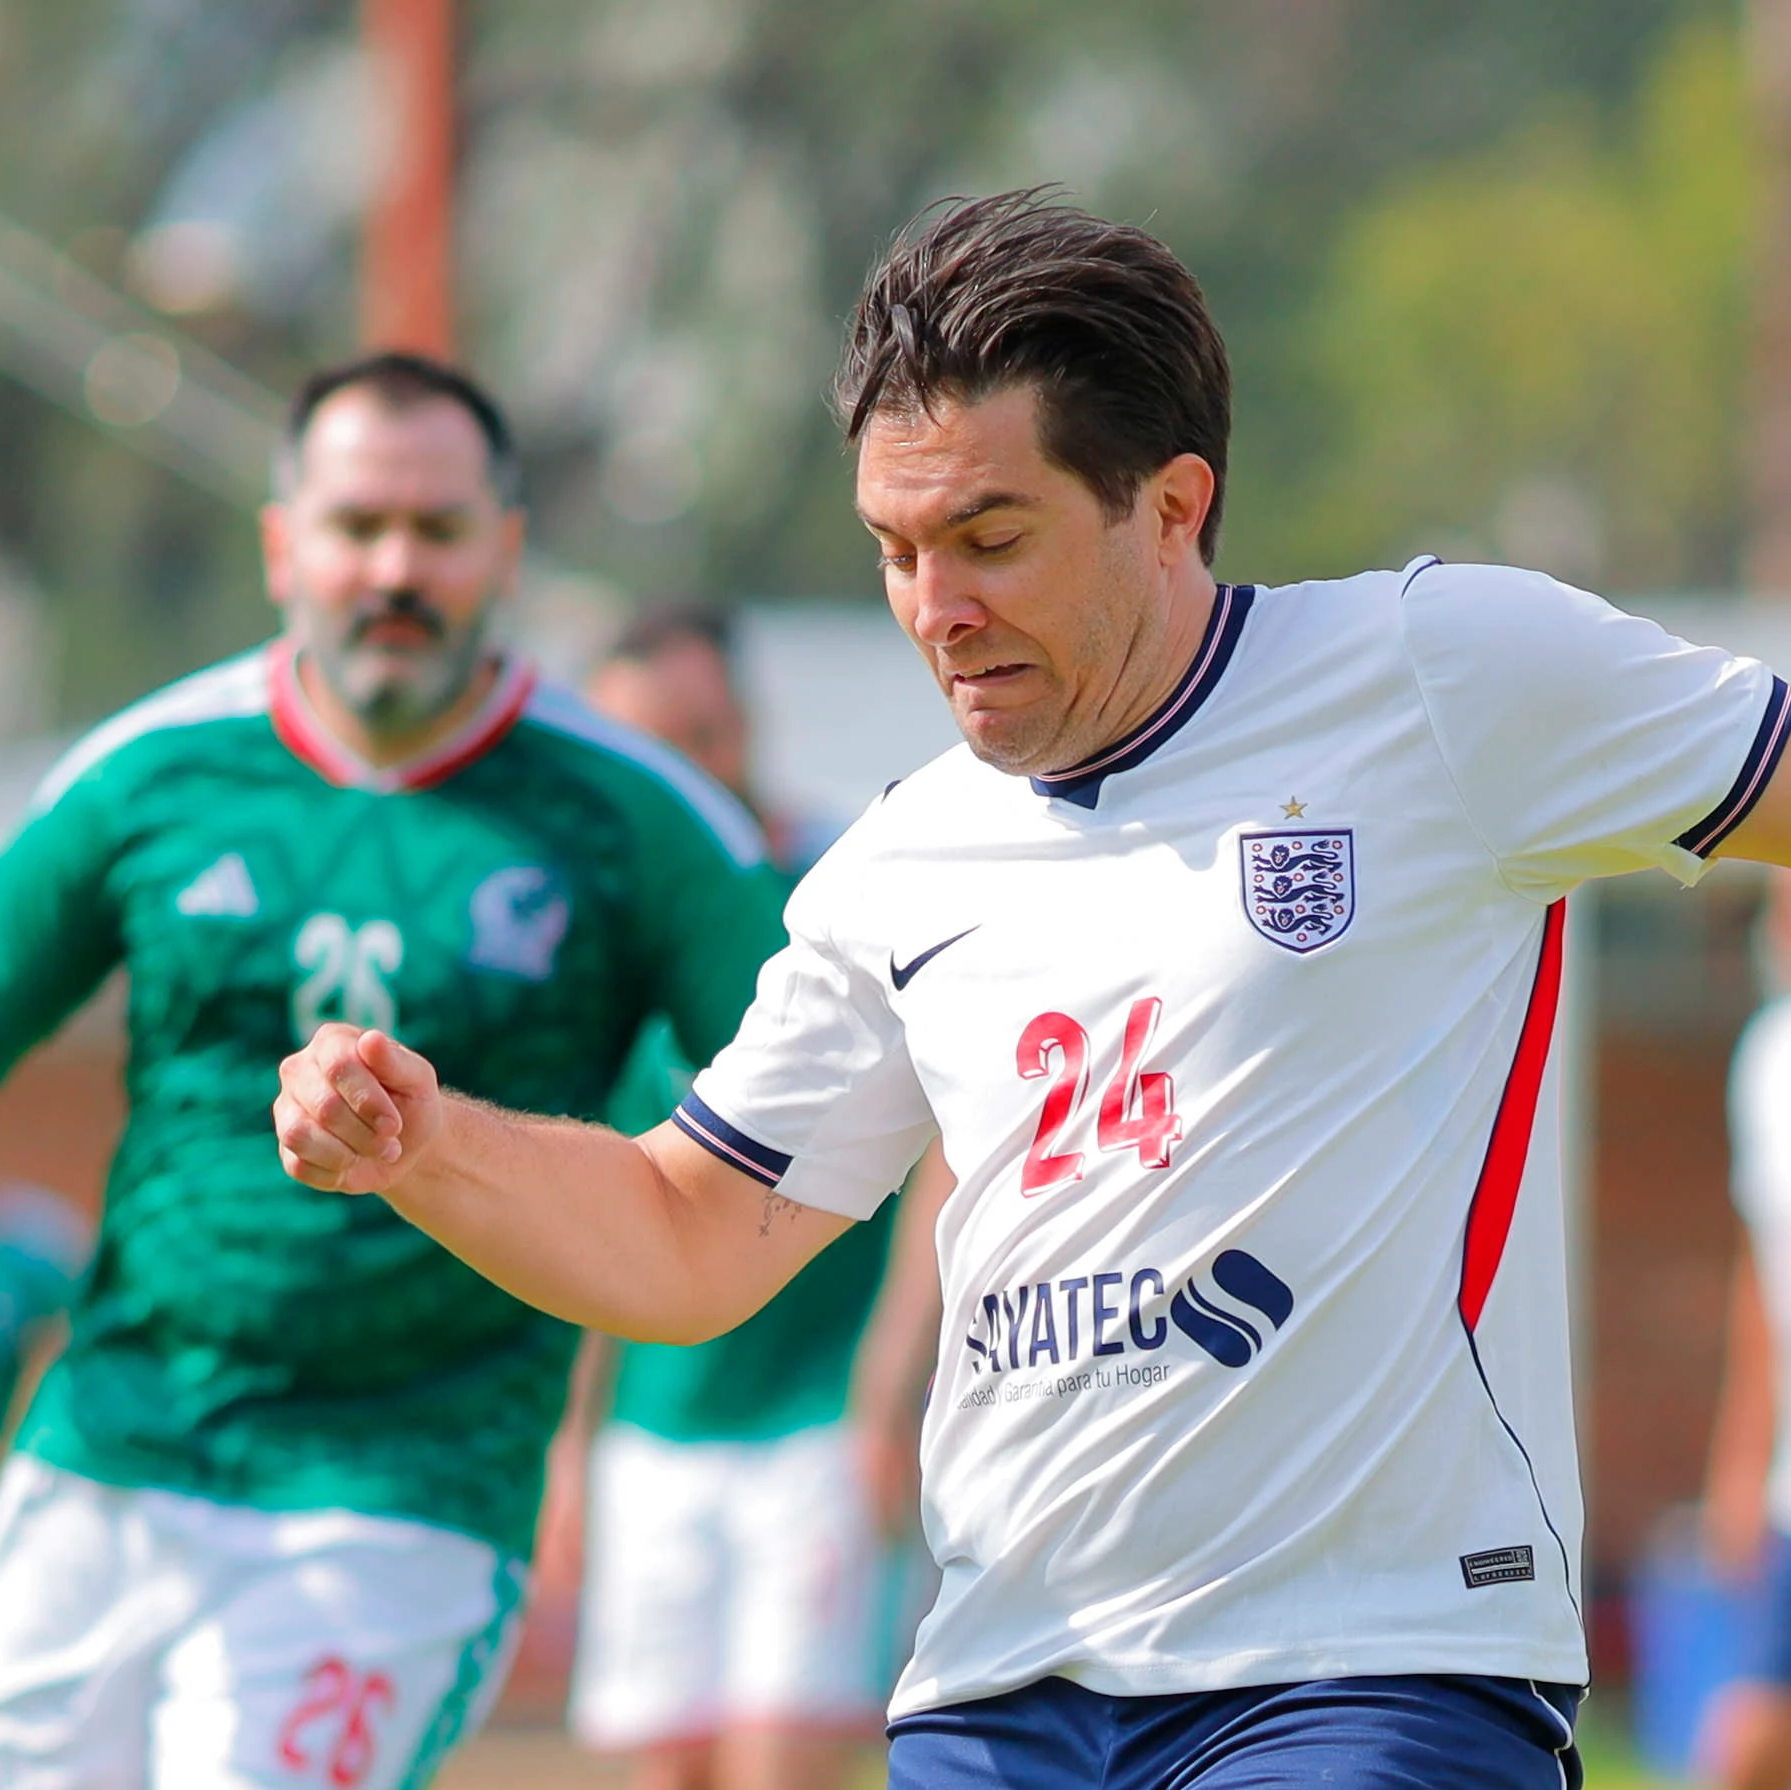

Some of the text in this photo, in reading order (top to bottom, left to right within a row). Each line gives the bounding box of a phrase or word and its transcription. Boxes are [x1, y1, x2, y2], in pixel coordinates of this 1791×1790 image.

[293, 911, 401, 1042] 26
[1015, 996, 1182, 1199] 24
[1057, 1372, 1092, 1399] para
[1096, 1368, 1111, 1389] tu
[1116, 1363, 1171, 1389] Hogar
[276, 1655, 397, 1790] 26
